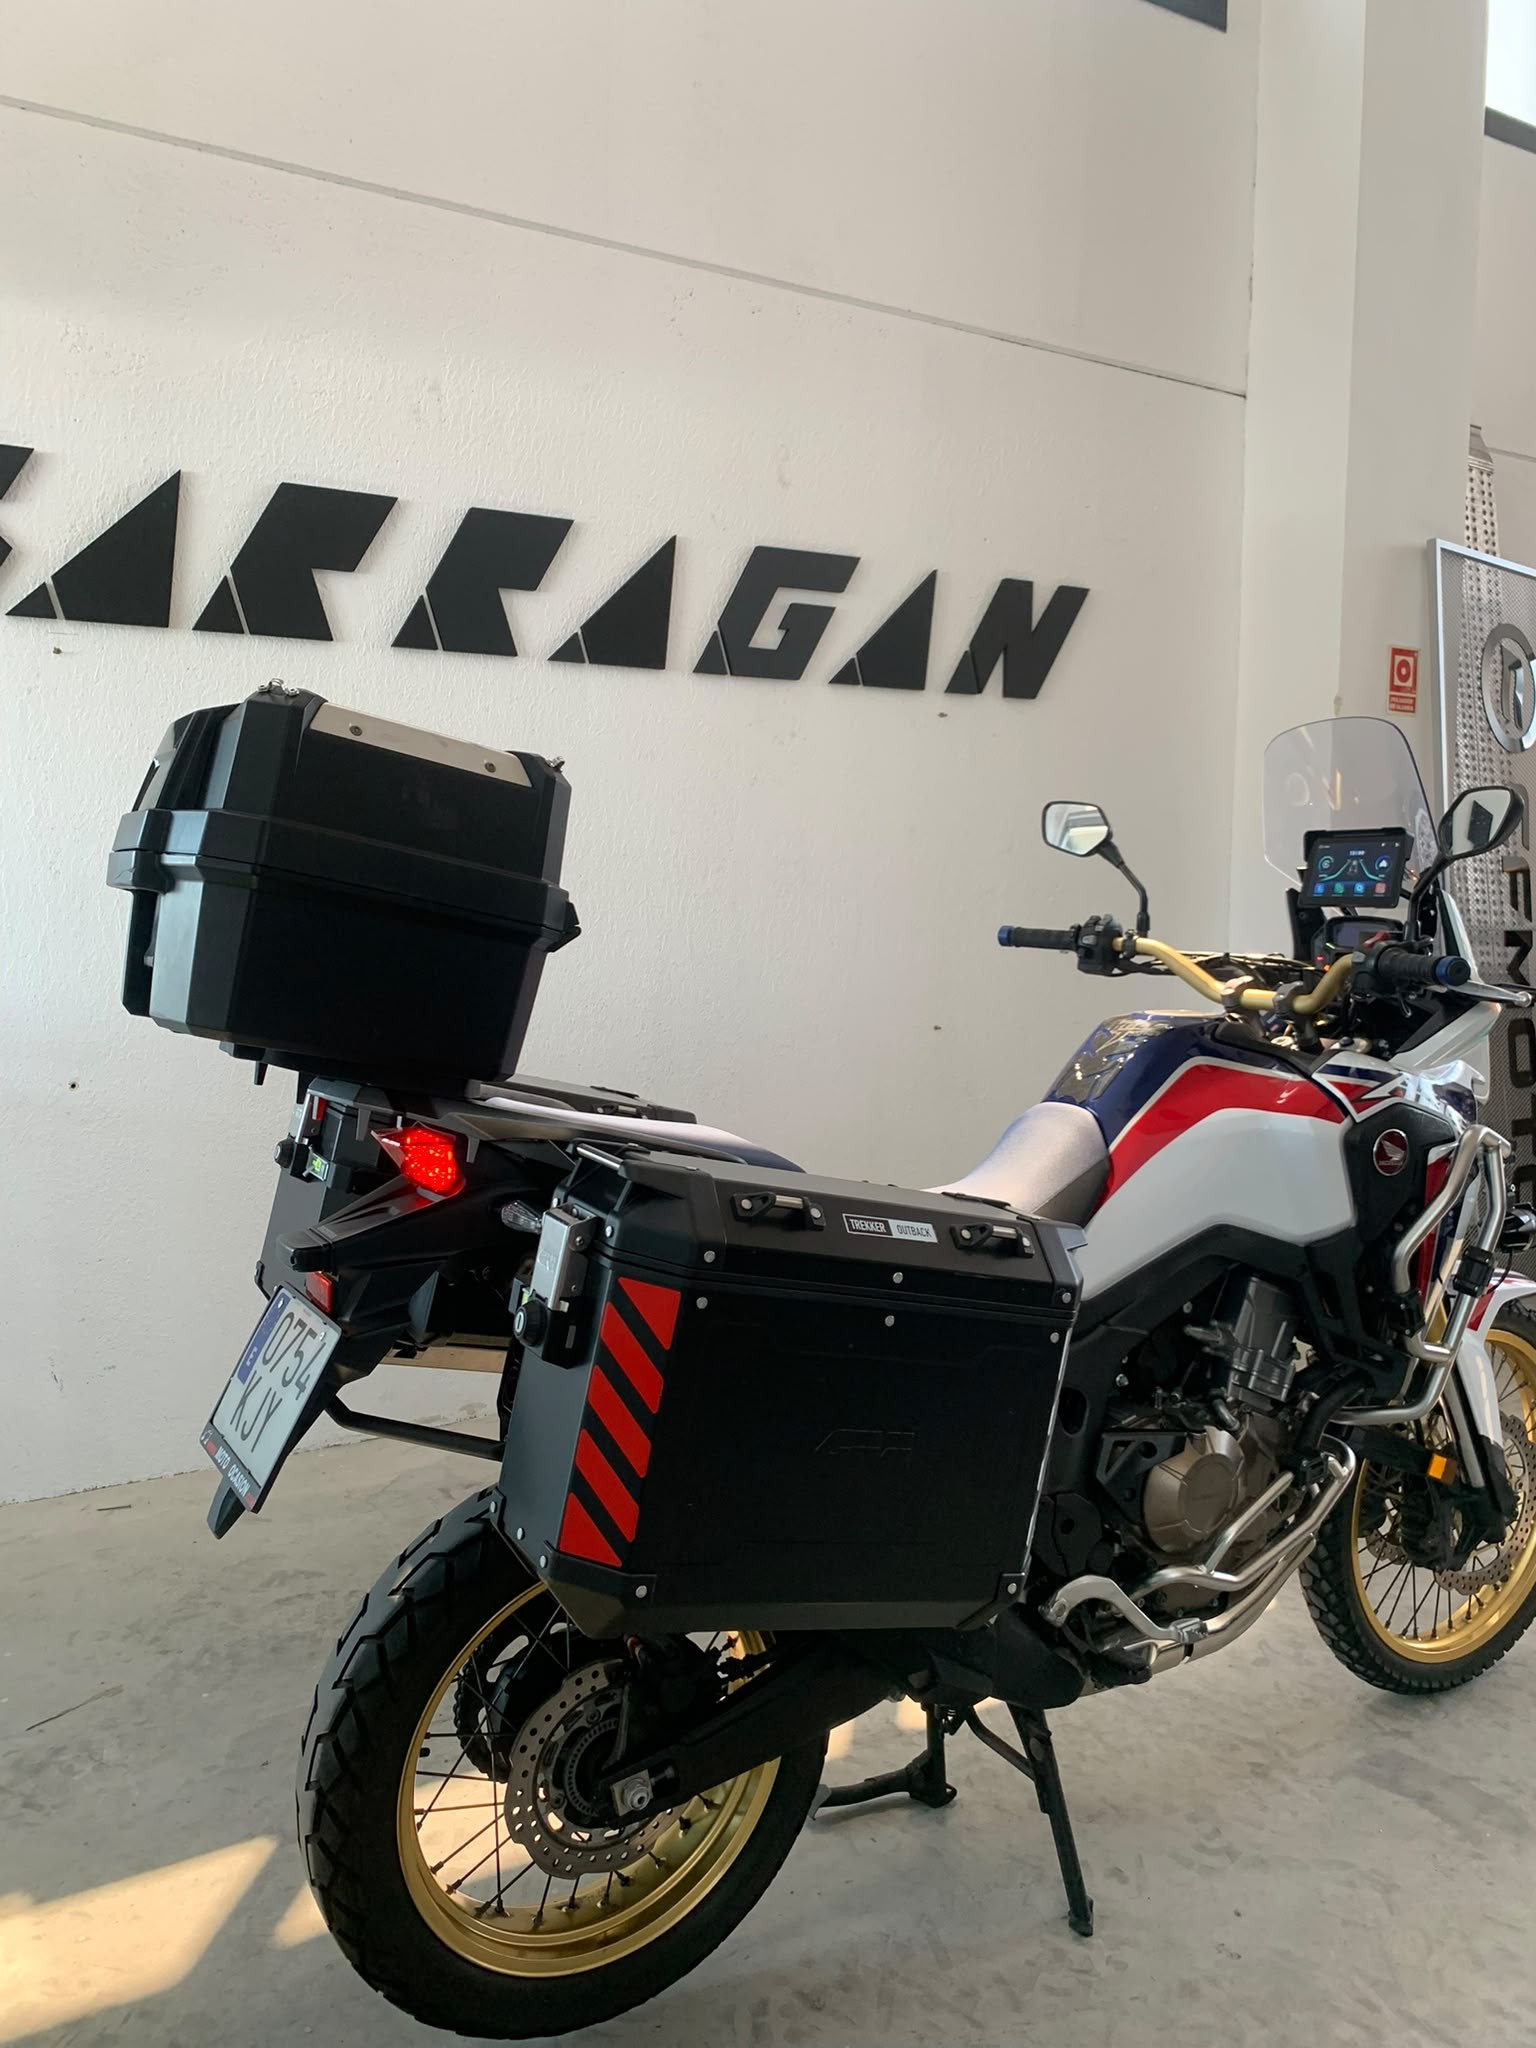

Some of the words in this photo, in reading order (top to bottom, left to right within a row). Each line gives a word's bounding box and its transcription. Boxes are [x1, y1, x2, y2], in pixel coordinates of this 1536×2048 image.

[849, 1218, 886, 1233] TREKKER
[896, 1224, 932, 1238] OUTBACK
[262, 1311, 326, 1401] 0754
[230, 1369, 283, 1453] KJY
[214, 1446, 231, 1470] MOTO
[228, 1463, 251, 1497] OCASION
